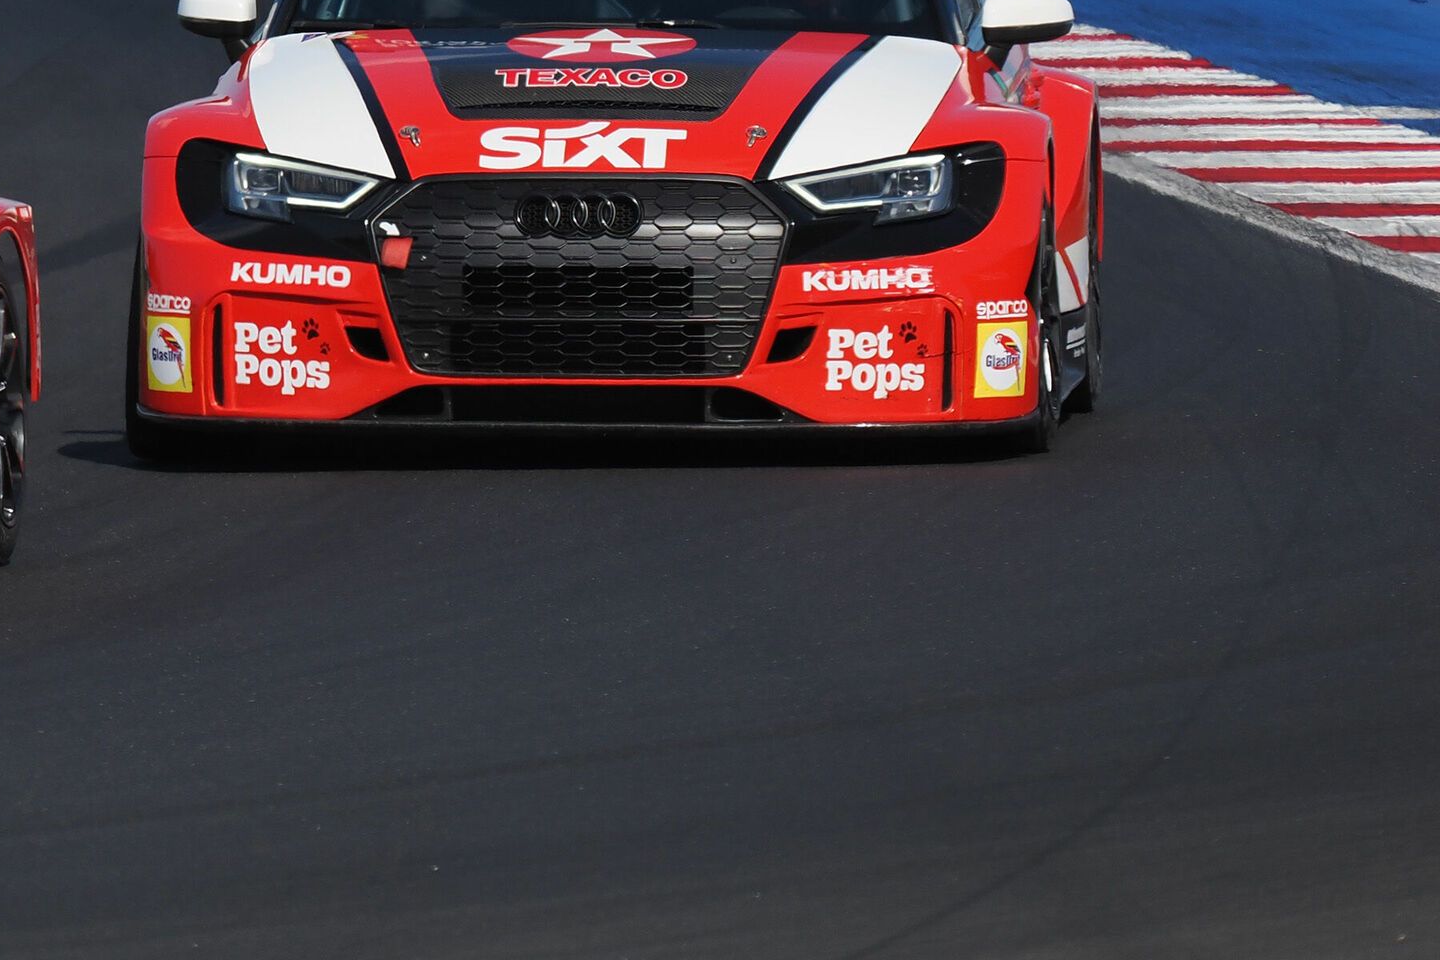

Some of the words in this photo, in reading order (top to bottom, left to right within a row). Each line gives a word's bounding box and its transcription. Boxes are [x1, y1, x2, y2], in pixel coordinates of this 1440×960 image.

[494, 68, 688, 90] TEXACO
[230, 261, 352, 288] KUMHO
[802, 267, 934, 292] KUMHO
[147, 293, 191, 311] sparco
[976, 300, 1028, 318] sparco
[234, 319, 298, 355] Pet
[827, 325, 893, 359] Pet
[234, 353, 331, 395] Pops
[825, 359, 925, 399] Pops
